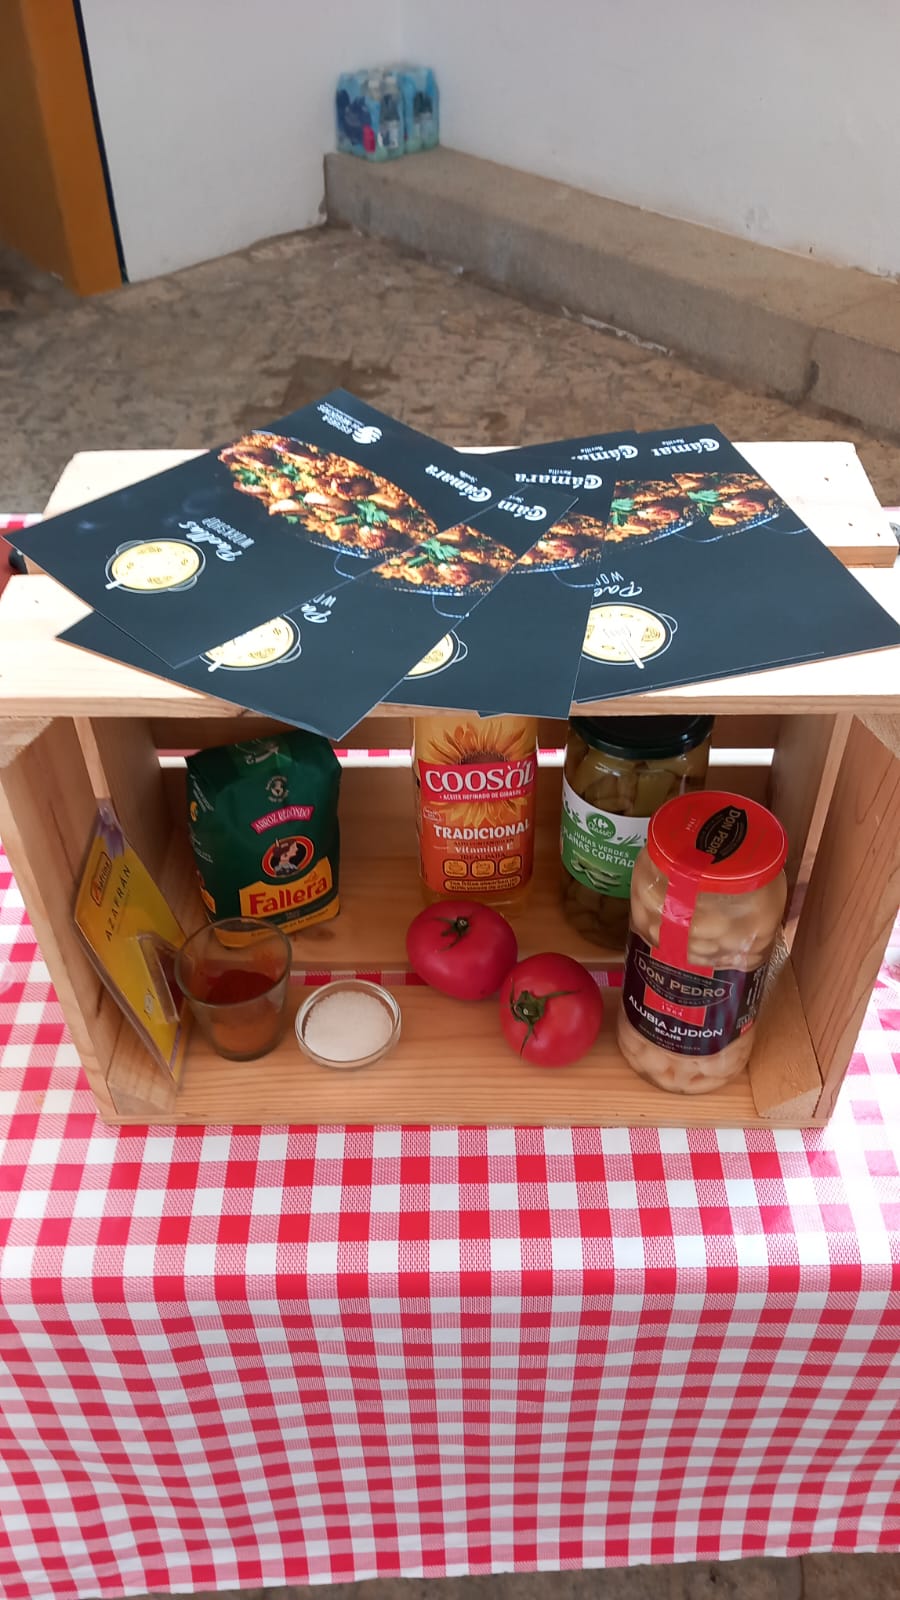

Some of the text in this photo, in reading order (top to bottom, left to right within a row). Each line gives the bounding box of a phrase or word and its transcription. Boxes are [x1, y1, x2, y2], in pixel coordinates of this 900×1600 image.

[424, 464, 492, 502] Cámara
[514, 472, 603, 490] Cámara
[254, 813, 279, 832] ARROZ
[722, 808, 741, 831] DON
[455, 845, 504, 854] Vitamina
[598, 844, 630, 859] VERDES
[248, 877, 328, 916] Fallera
[638, 957, 665, 985] DON
[669, 979, 726, 998] PEDRO
[628, 994, 667, 1031] ALUBIA
[669, 1025, 723, 1038] JUDIÓN
[655, 1026, 682, 1041] BEANS
